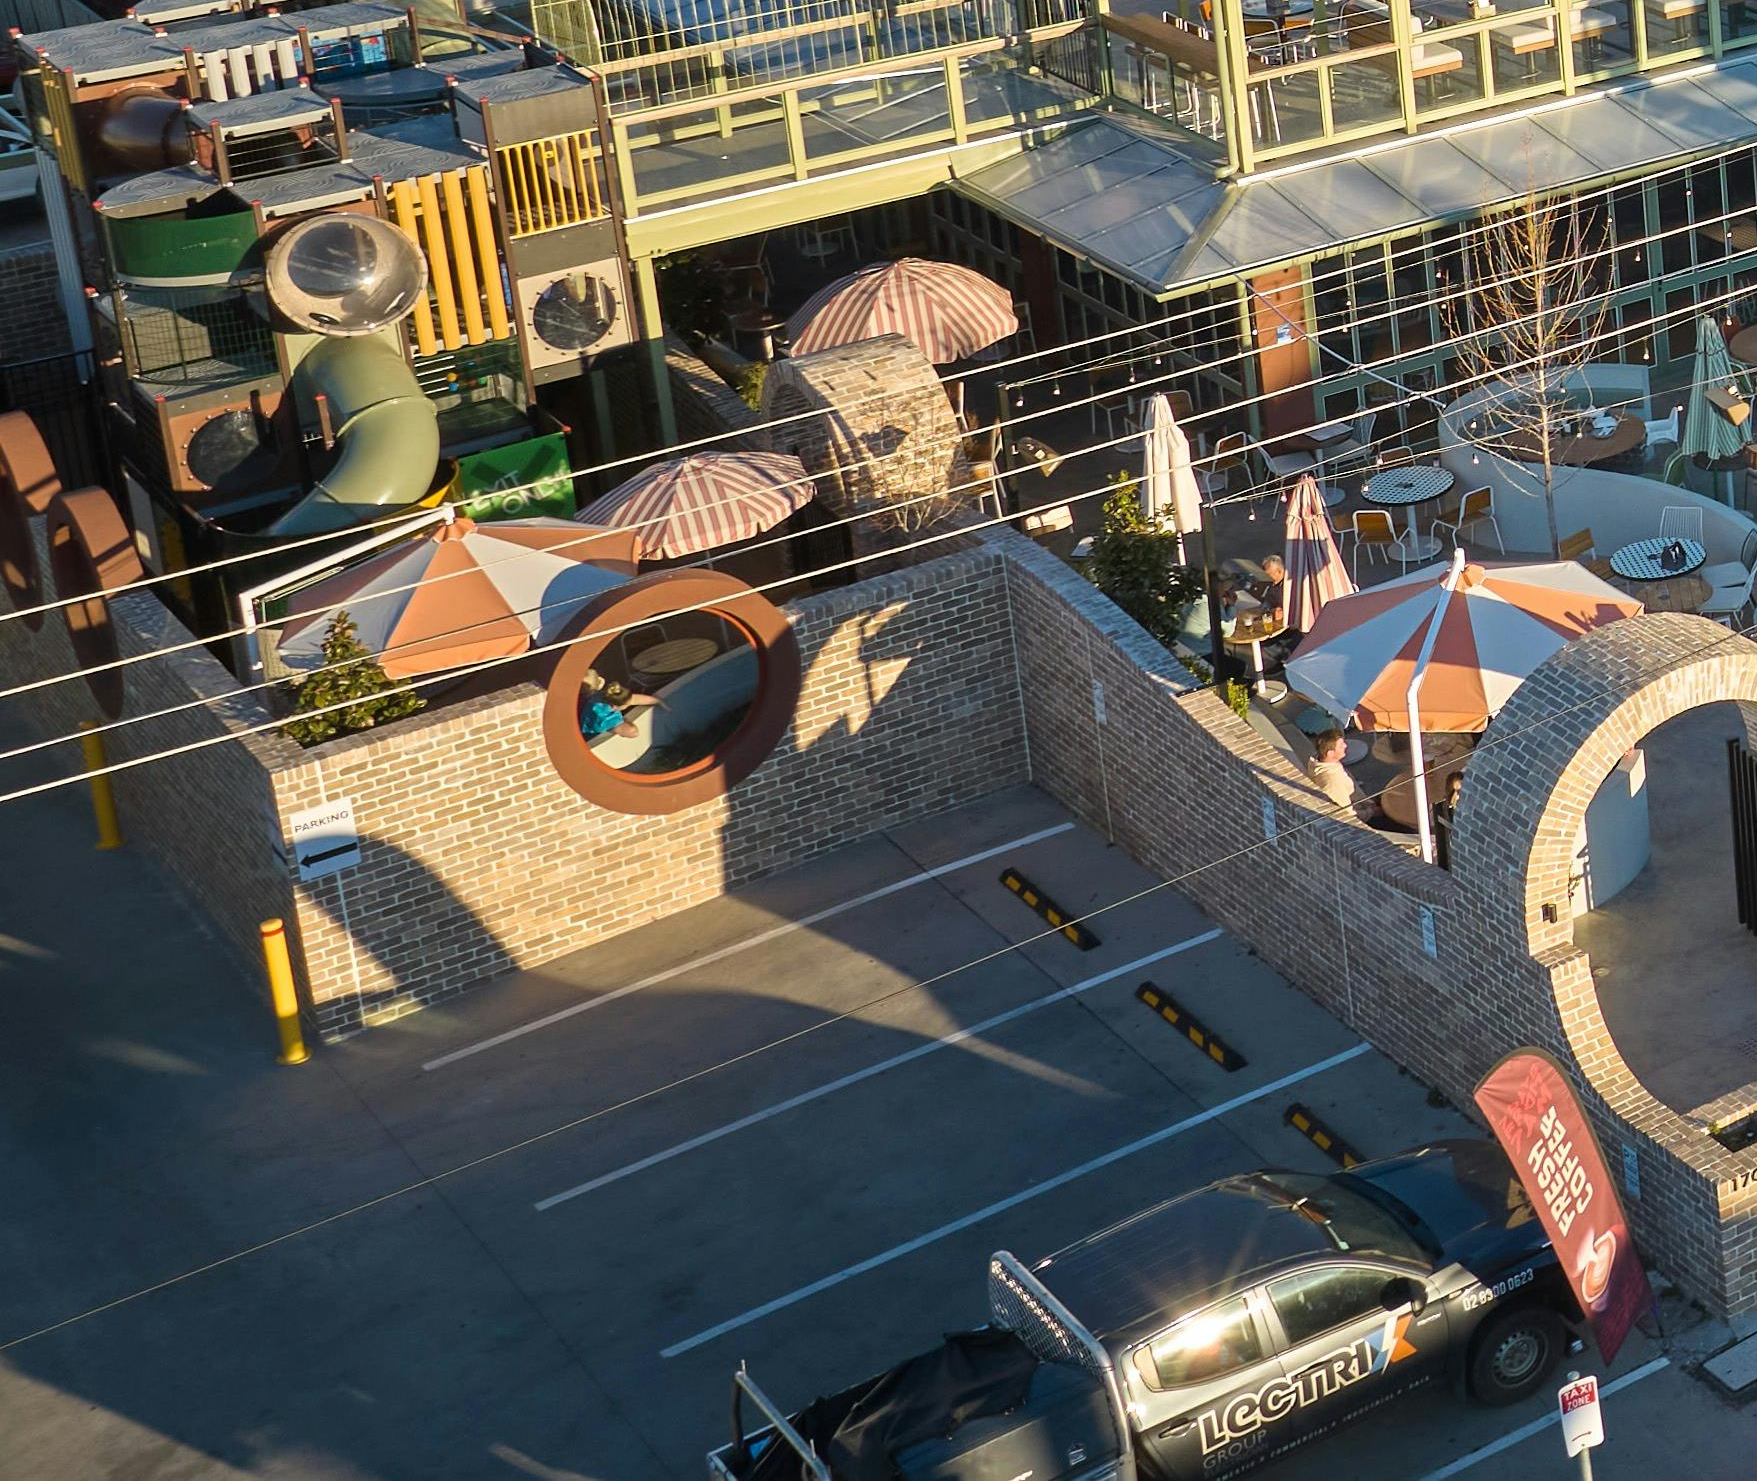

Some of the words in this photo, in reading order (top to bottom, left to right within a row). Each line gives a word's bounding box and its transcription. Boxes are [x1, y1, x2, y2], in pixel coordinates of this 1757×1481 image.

[294, 810, 349, 833] PARKING
[1539, 1105, 1594, 1215] COFFEE
[1527, 1138, 1576, 1238] FRESH
[1462, 1293, 1478, 1312] 02
[1507, 1268, 1535, 1295] 0623
[1563, 1383, 1592, 1401] TAXI
[1567, 1394, 1591, 1411] ZONE
[1203, 1429, 1267, 1470] GROUP
